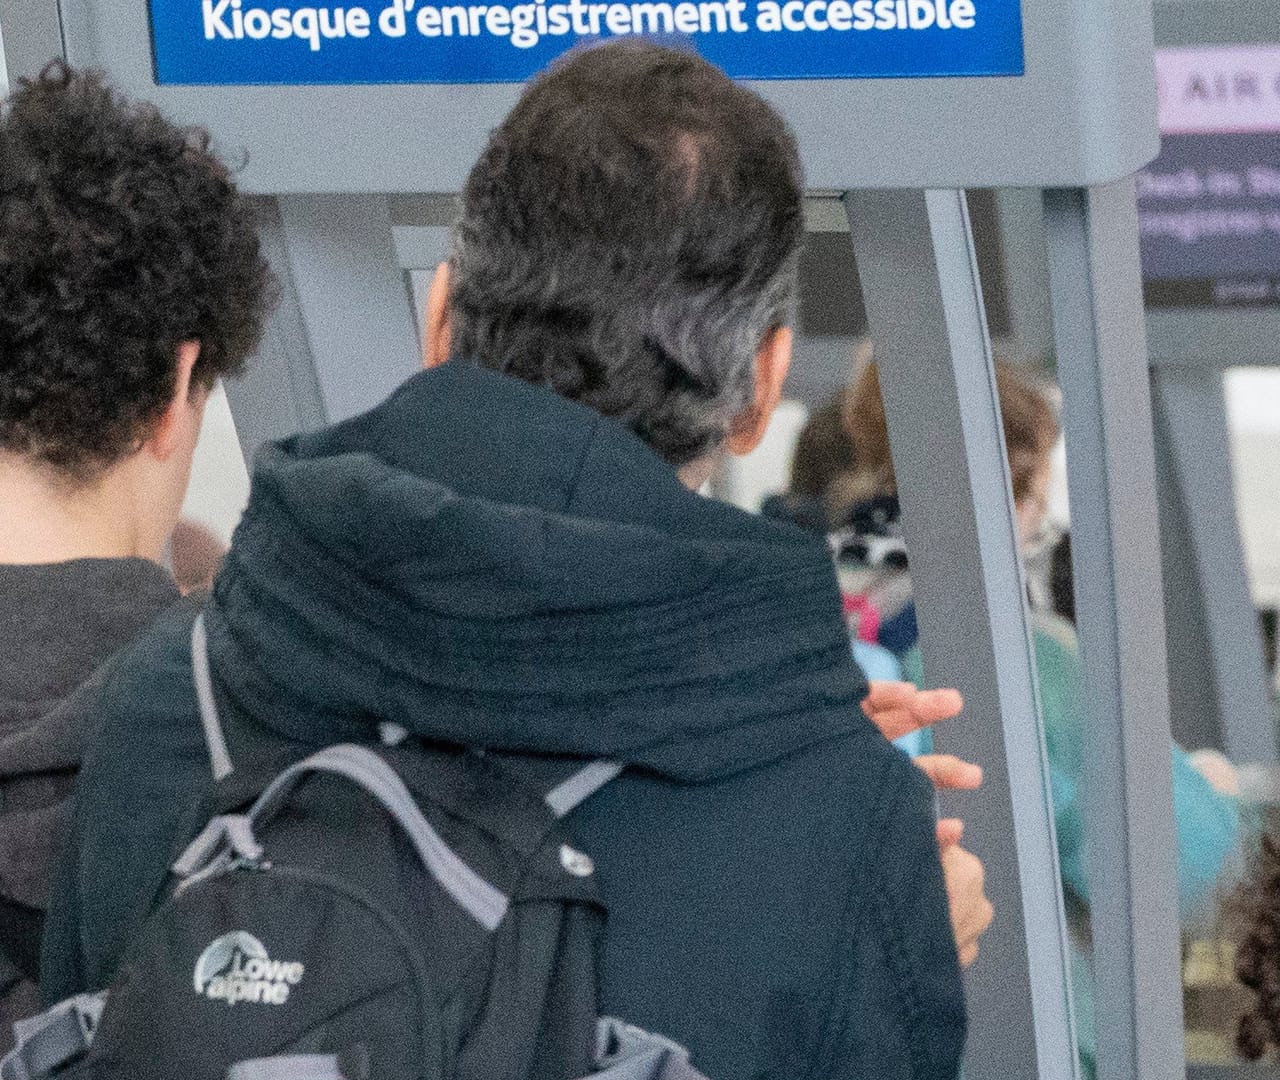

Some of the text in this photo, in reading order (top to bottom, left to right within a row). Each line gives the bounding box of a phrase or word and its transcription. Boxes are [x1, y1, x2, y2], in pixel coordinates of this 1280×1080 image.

[203, 0, 371, 51] Kiosque
[755, 0, 976, 32] accessible
[231, 951, 304, 985] Lowe
[207, 975, 290, 1006] alpine
